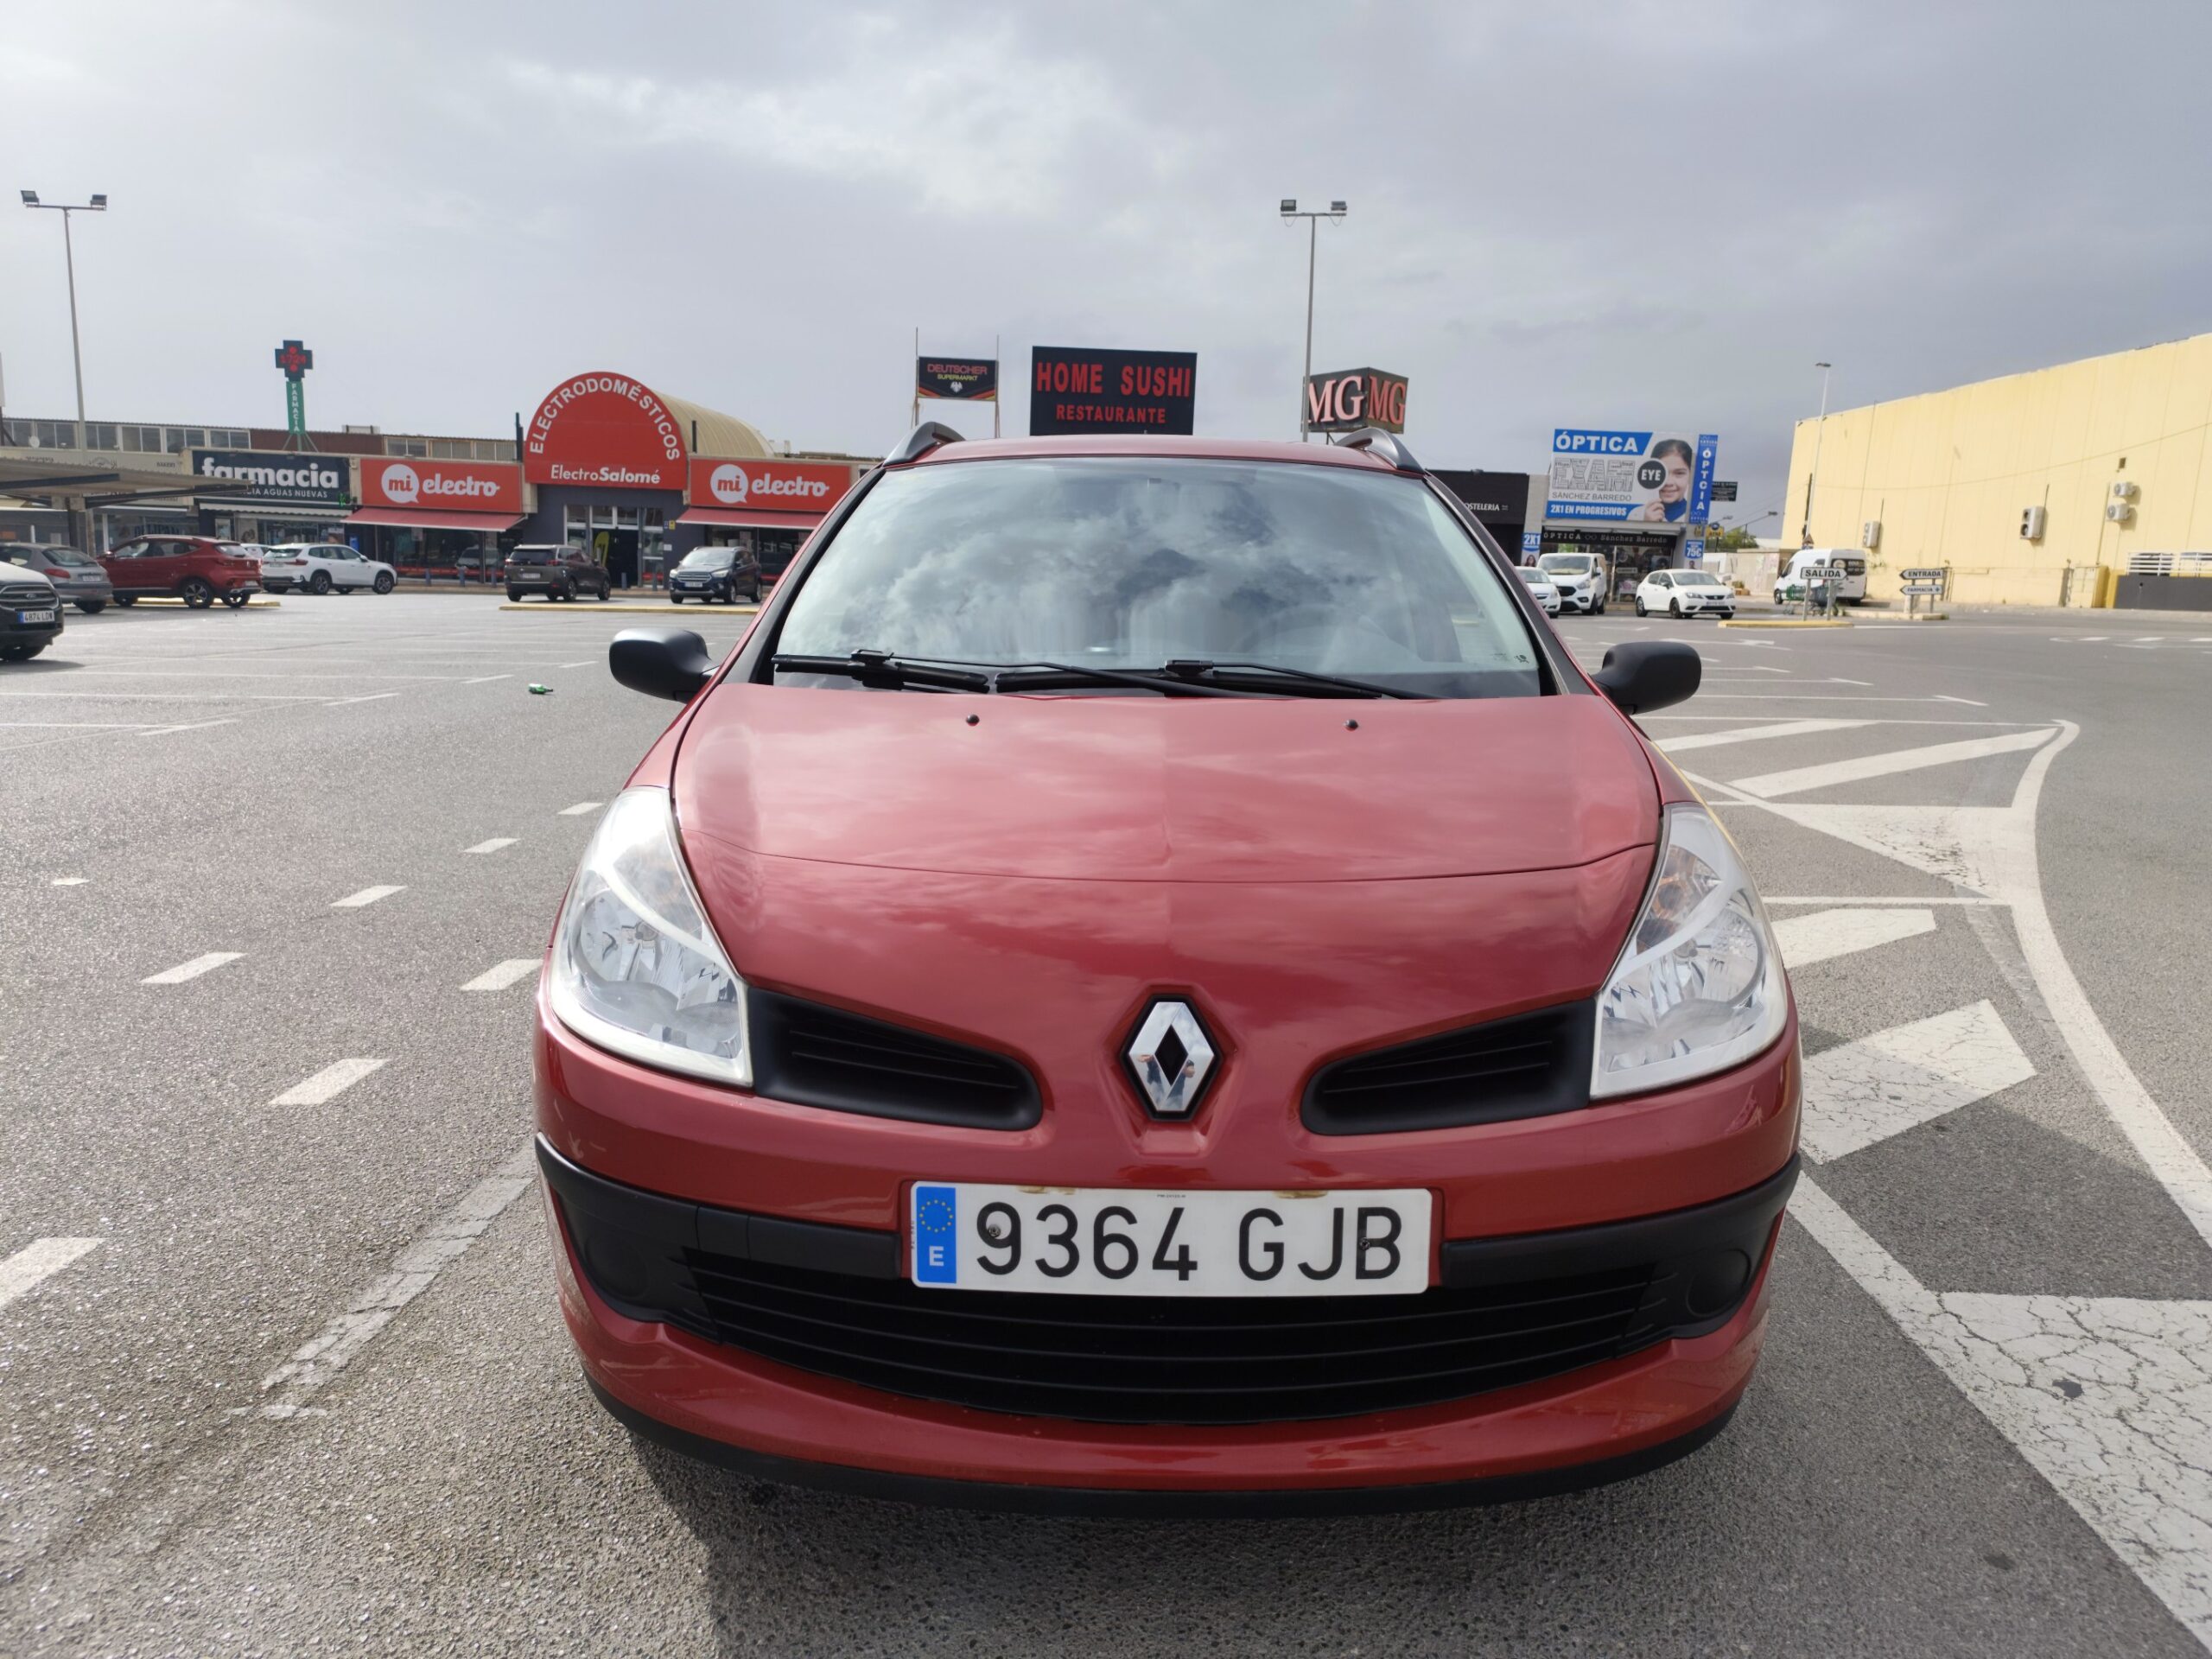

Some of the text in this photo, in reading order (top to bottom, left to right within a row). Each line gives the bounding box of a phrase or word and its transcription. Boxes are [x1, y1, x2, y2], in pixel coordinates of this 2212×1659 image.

[927, 364, 988, 375] DEUTSCHER
[1037, 361, 1191, 397] HOME SUSHI
[291, 383, 300, 432] FARMACIA
[1308, 375, 1364, 423] MG
[1368, 373, 1406, 425] MG
[529, 378, 680, 461] ELECTRODOMÉSTICOS
[1056, 404, 1166, 423] RESTAURANTE
[1555, 431, 1638, 453] ÓPTICA
[201, 457, 339, 489] farmacia
[550, 464, 661, 484] ElectroSalomé
[1642, 469, 1662, 481] EYE
[264, 488, 293, 497] AGUAS
[295, 490, 328, 499] NUEVAS
[388, 473, 501, 497] mi electro
[717, 473, 830, 497] mi electro
[1592, 493, 1632, 502] BARREDO
[1550, 504, 1627, 516] 2X1 EN PROGRESIVOS
[1523, 534, 1541, 545] 2X1
[1805, 569, 1841, 578] SALIDA
[975, 1201, 1403, 1282] 9364 GJB
[929, 1245, 944, 1267] E
